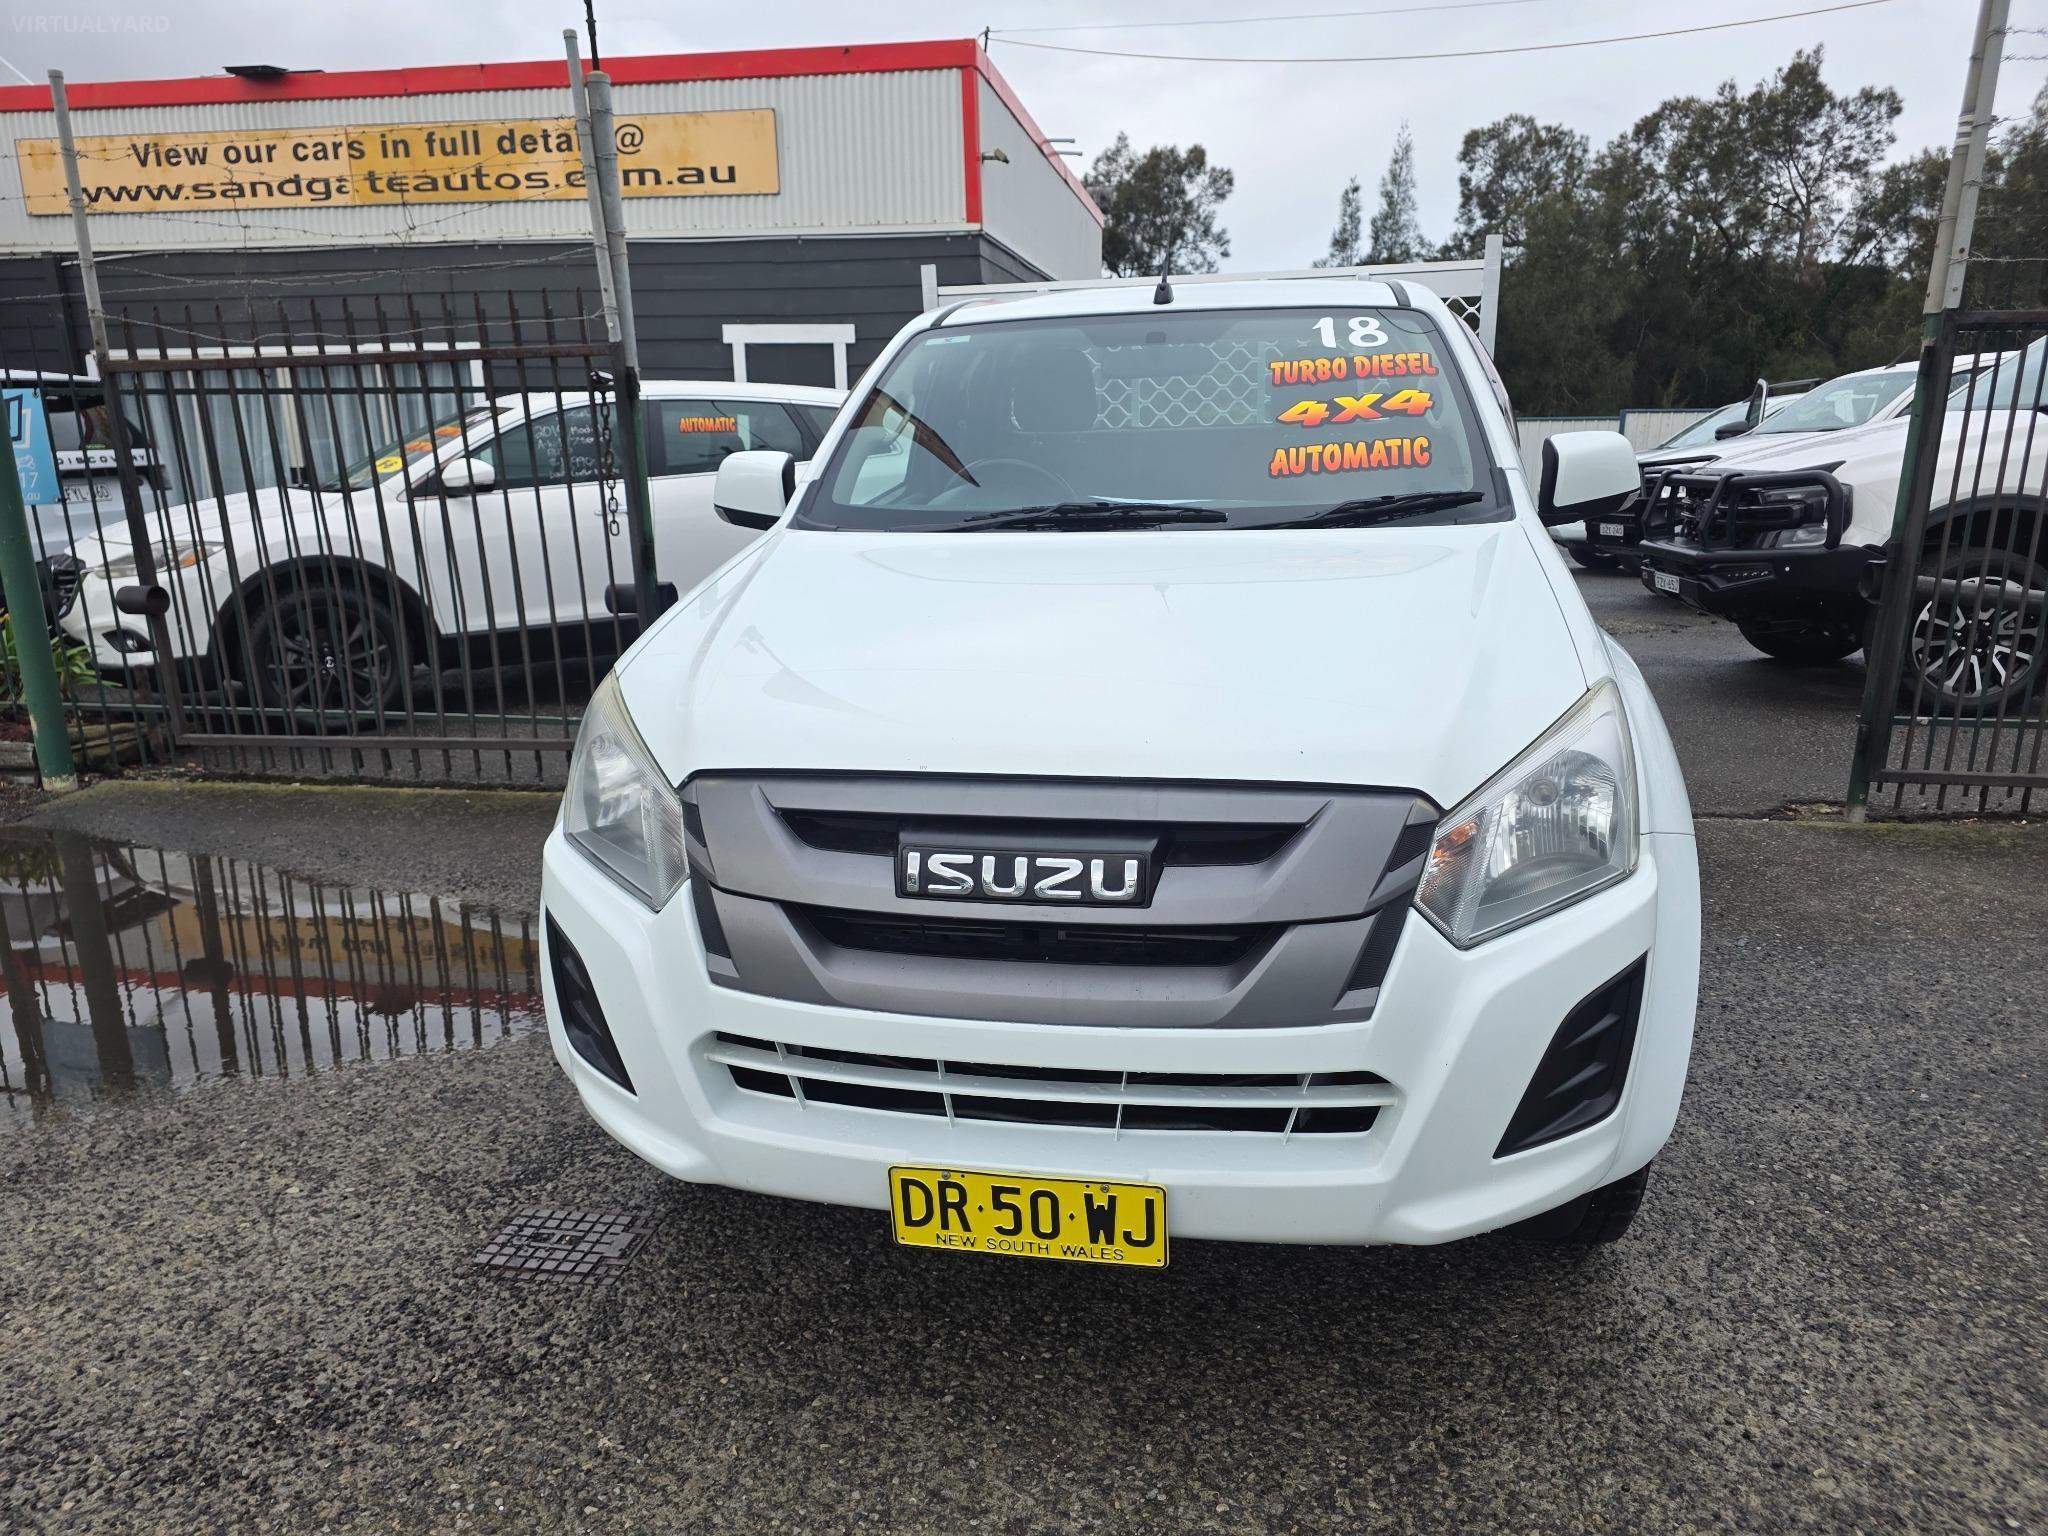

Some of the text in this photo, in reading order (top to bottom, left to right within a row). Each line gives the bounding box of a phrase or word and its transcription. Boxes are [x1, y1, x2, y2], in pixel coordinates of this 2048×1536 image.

[131, 143, 208, 168] View
[223, 144, 277, 164] our
[292, 139, 366, 162] cars
[380, 133, 411, 159] in
[425, 129, 481, 158] full
[1311, 316, 1389, 349] 18
[1270, 352, 1438, 386] TURBO DIESEL
[679, 416, 737, 433] AUTOMATIC
[1269, 436, 1431, 477] AUTOMATIC
[906, 851, 1139, 901] ISUZU
[936, 1232, 1125, 1261] NEW SOUTH WALES
